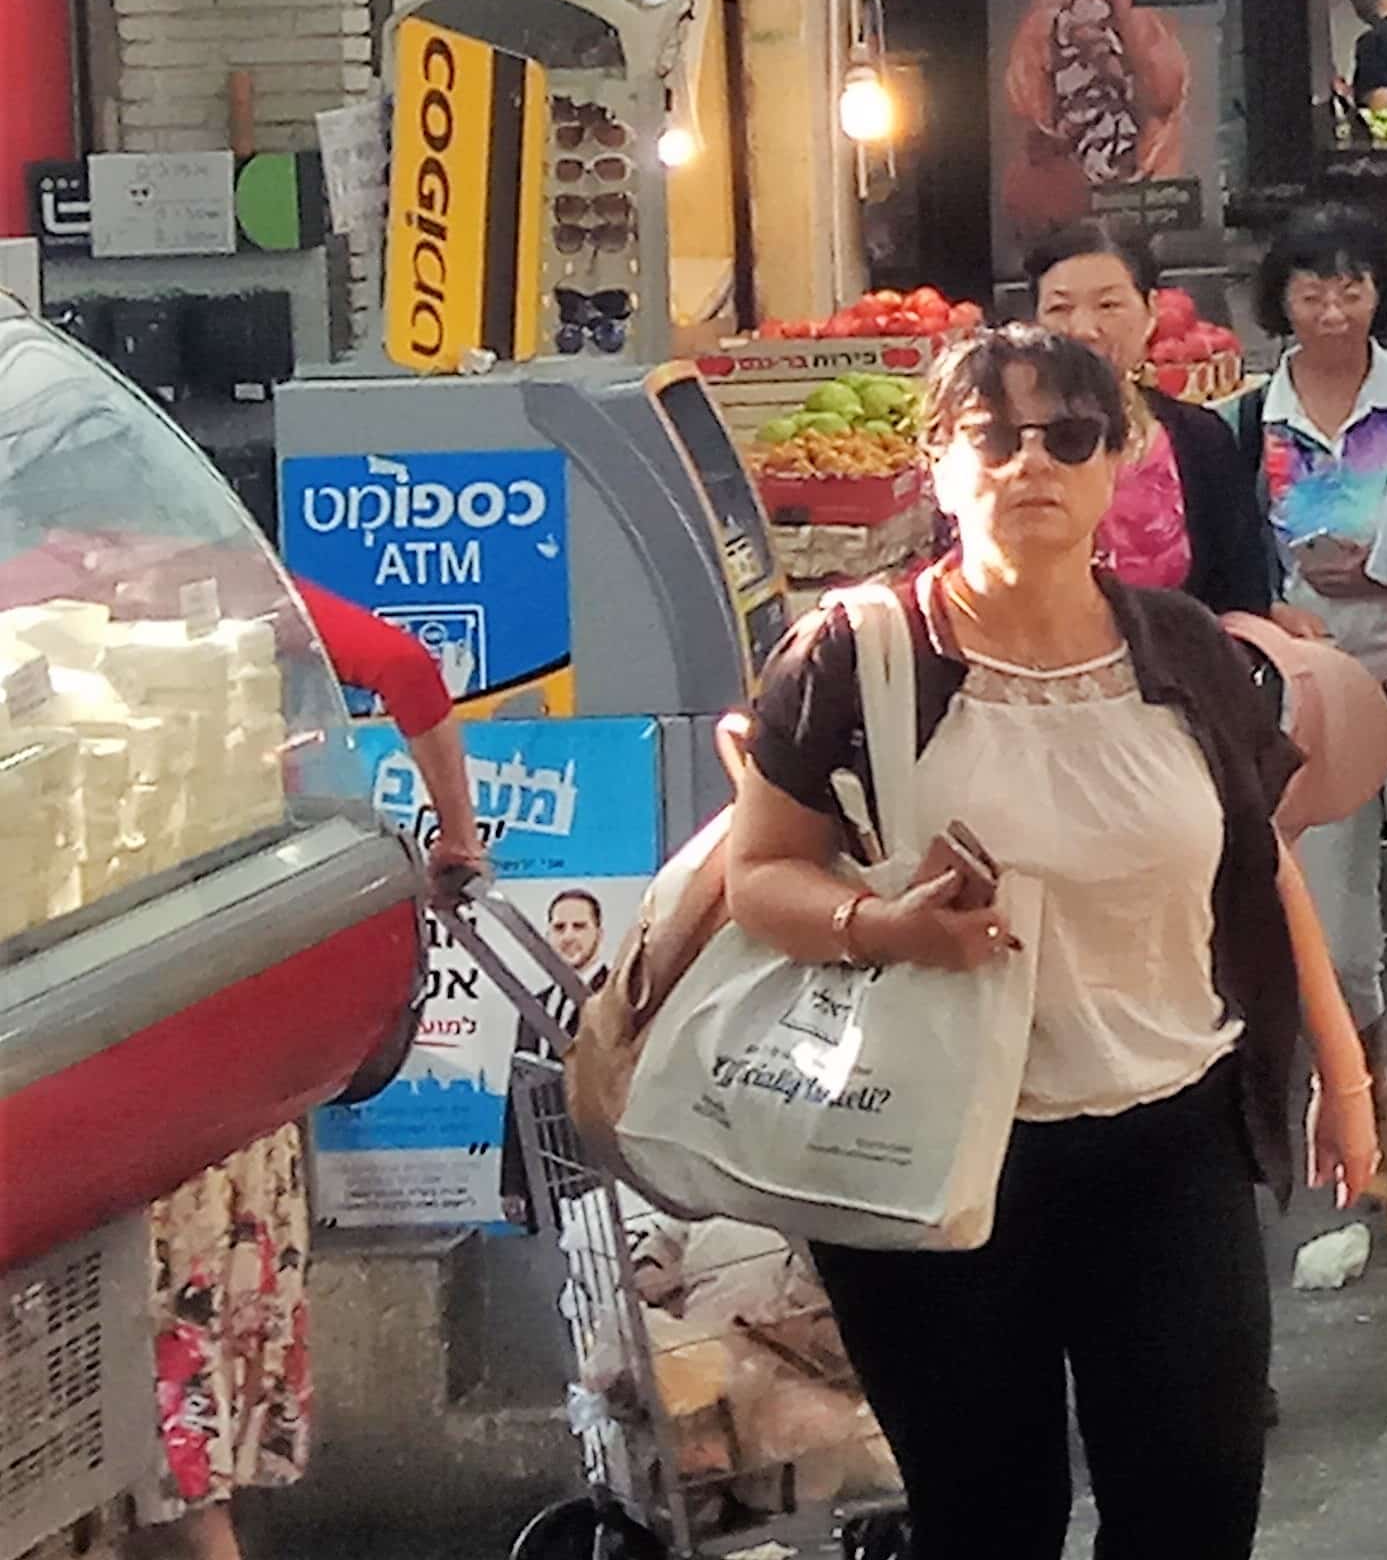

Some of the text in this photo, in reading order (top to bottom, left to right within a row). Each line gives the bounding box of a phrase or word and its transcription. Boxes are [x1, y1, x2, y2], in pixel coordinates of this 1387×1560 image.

[304, 480, 547, 534] כספומט
[375, 540, 480, 585] ATM
[417, 1016, 477, 1036] למוע
